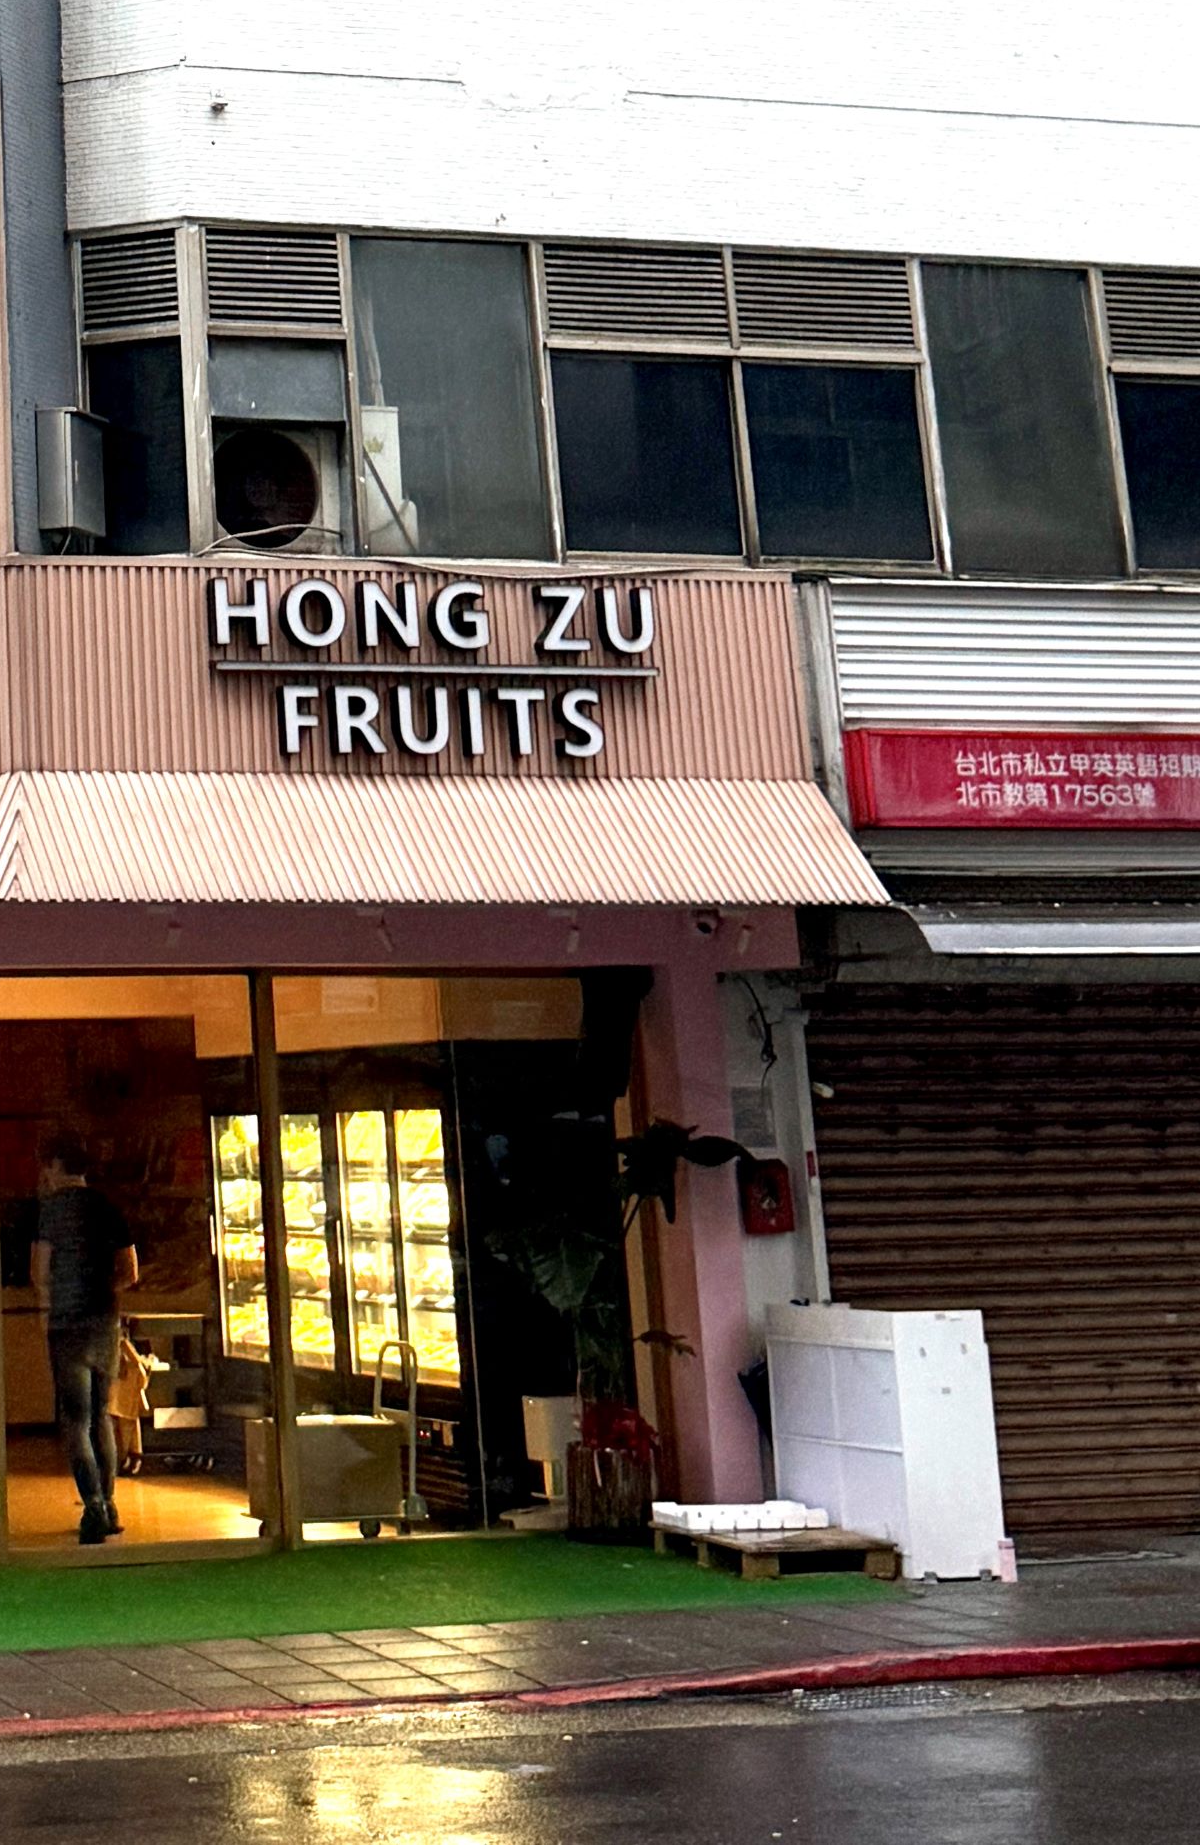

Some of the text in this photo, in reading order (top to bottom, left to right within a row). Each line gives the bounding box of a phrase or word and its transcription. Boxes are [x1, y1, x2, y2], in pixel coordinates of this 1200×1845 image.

[208, 576, 656, 655] HONG ZU
[277, 684, 605, 758] FRUITS
